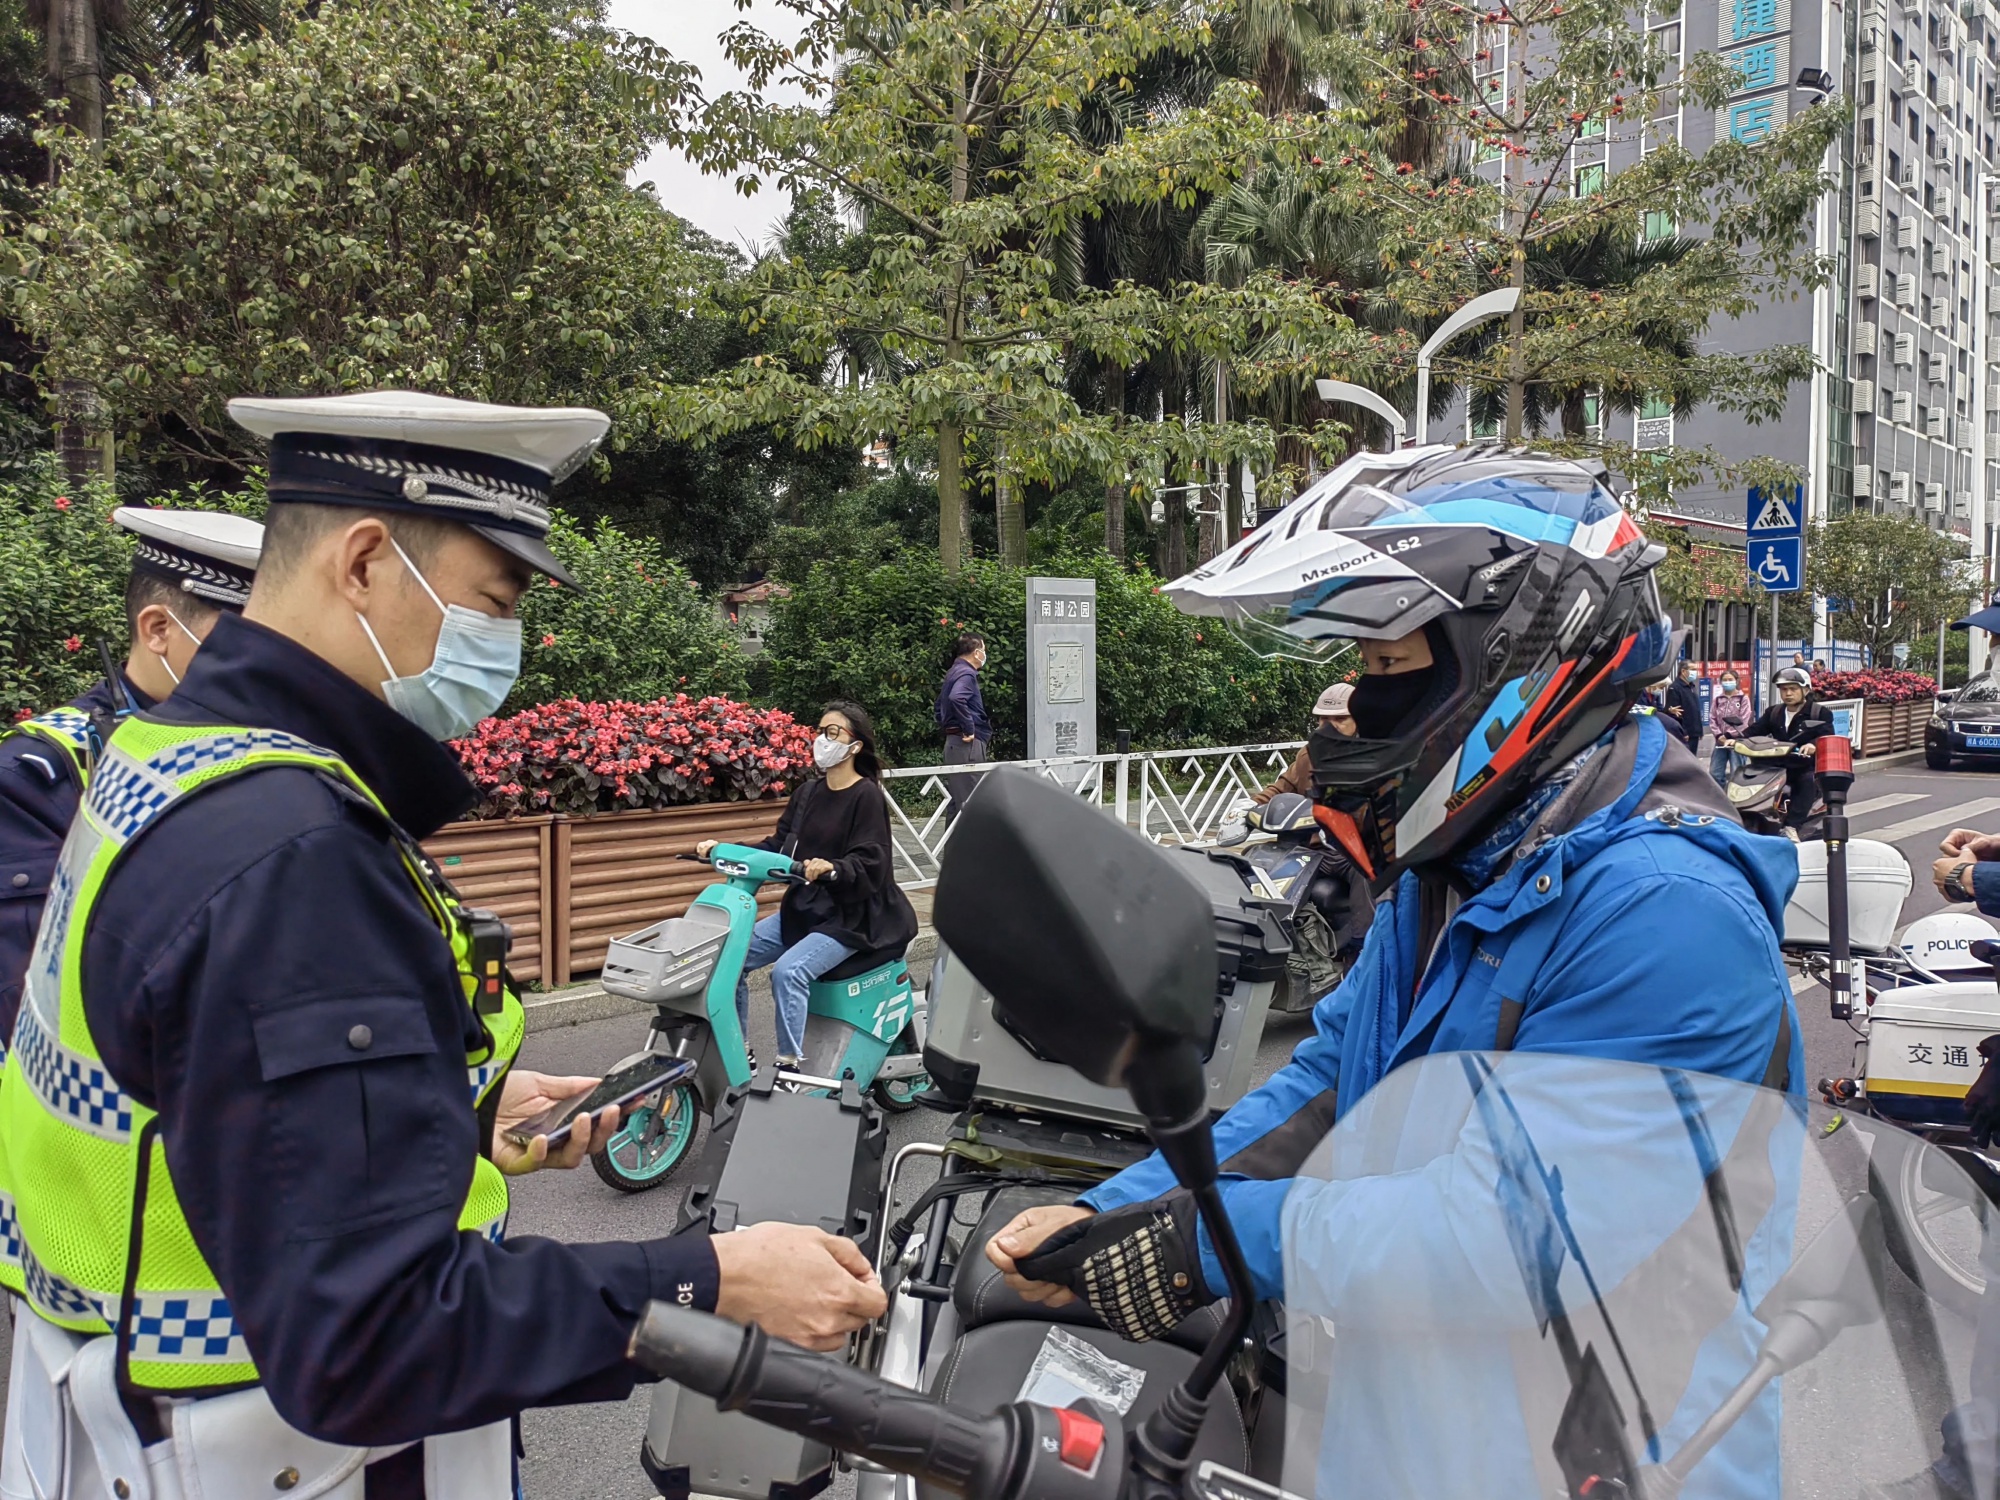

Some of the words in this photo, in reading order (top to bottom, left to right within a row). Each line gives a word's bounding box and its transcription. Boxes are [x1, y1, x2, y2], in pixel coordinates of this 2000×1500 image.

[1301, 551, 1378, 582] Mxsport
[1386, 536, 1422, 555] LS2
[1041, 600, 1090, 618] 南湖公园
[1979, 737, 2000, 747] 60C0
[871, 990, 909, 1043] 行
[1908, 1042, 1985, 1067] 交通
